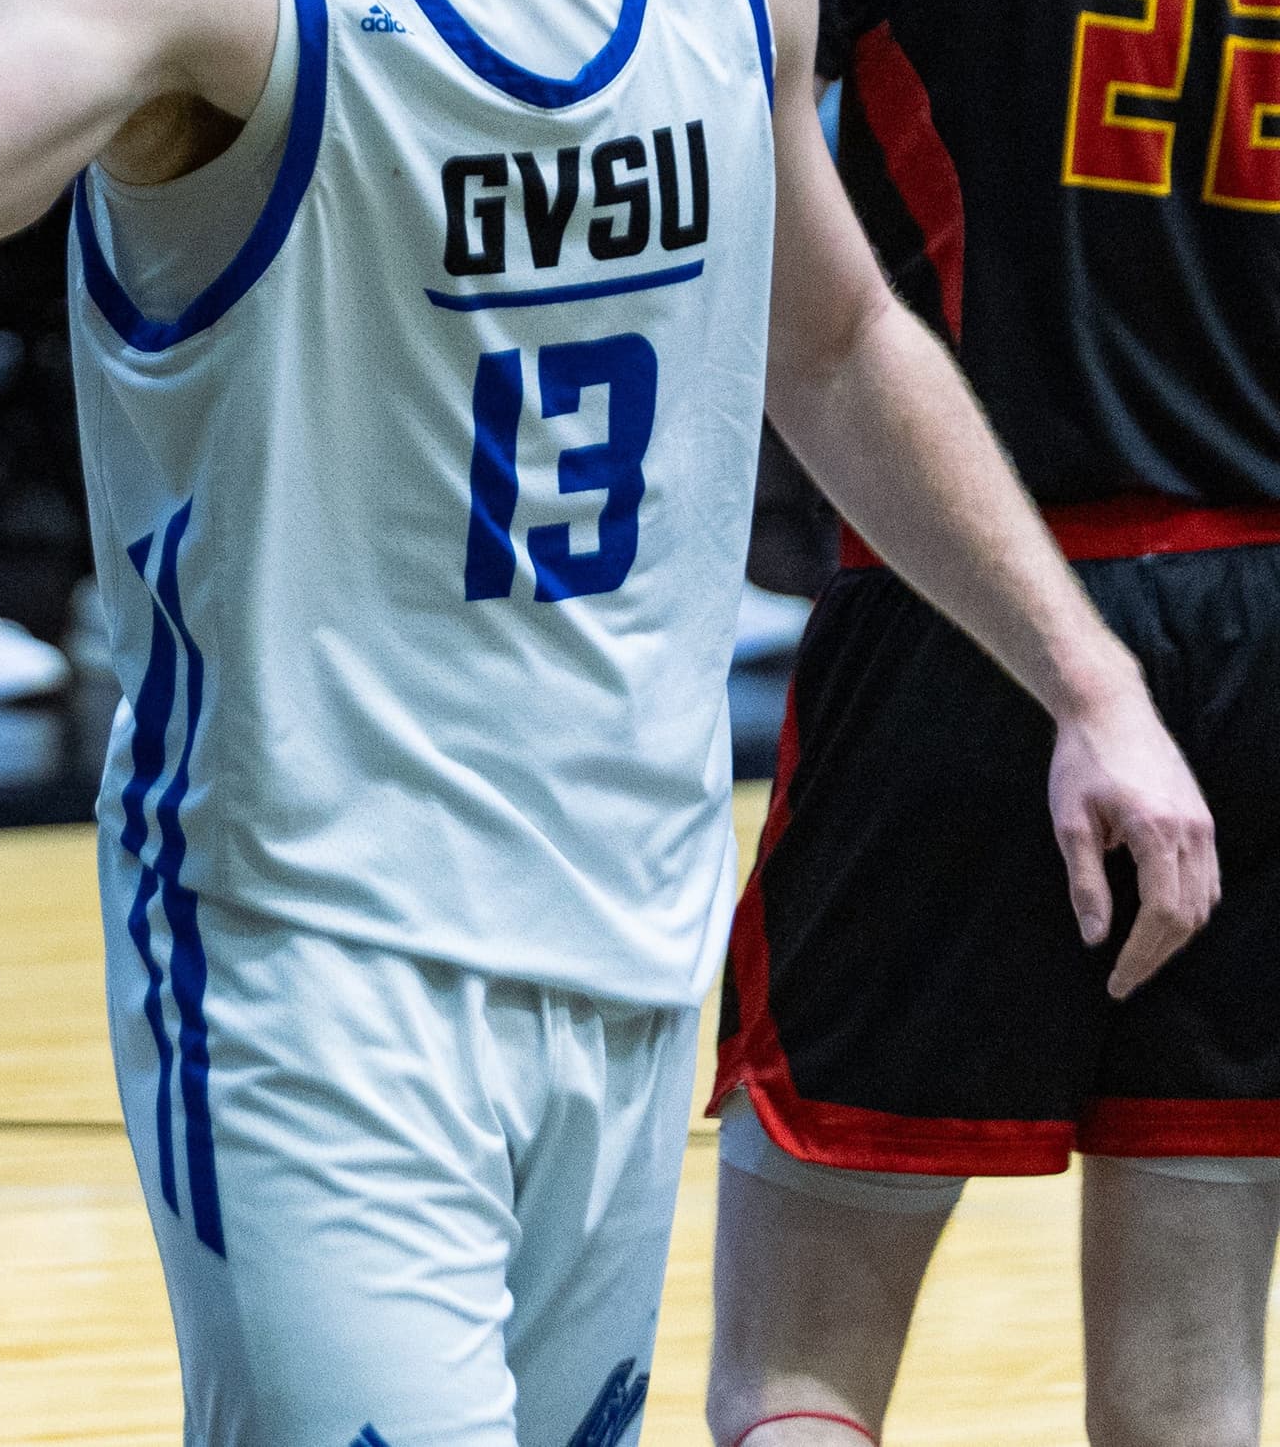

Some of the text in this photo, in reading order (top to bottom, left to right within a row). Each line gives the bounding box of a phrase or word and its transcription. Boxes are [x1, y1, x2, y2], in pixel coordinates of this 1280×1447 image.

[361, 12, 413, 33] adi
[442, 119, 710, 276] GVSU
[465, 332, 657, 602] 13
